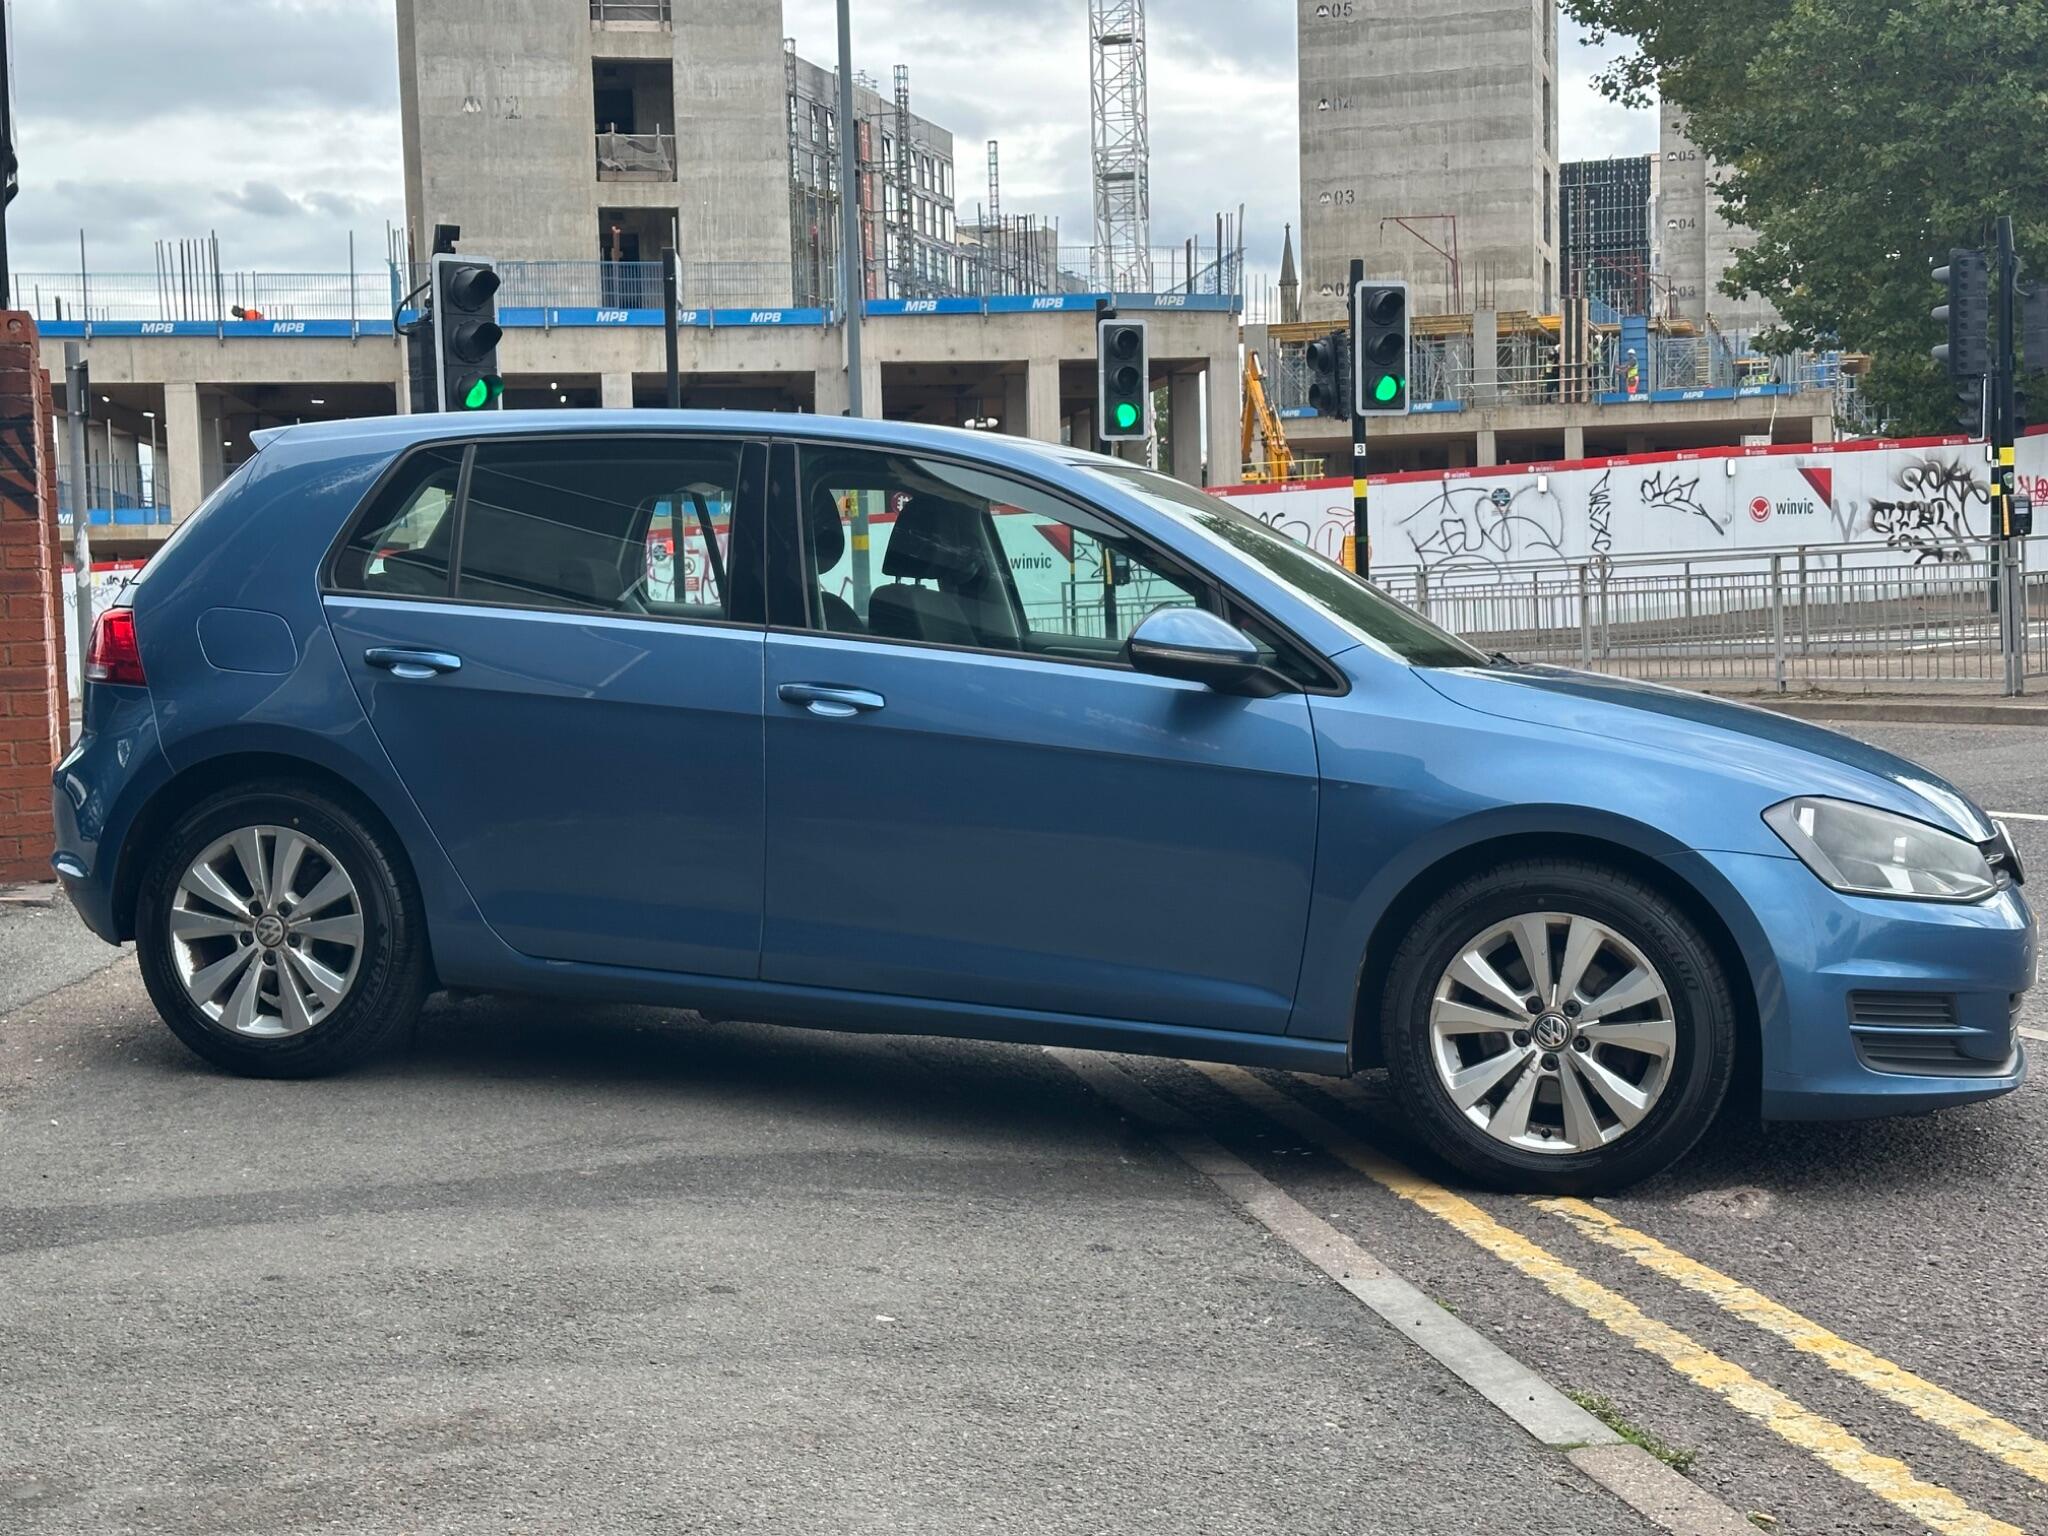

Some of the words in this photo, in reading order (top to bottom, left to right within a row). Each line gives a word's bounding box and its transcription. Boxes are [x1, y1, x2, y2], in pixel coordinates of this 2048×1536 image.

[1332, 1, 1352, 18] 05
[1334, 189, 1355, 205] 03
[904, 301, 937, 312] MPB
[1032, 297, 1064, 309] MPB
[1154, 295, 1186, 307] MPB
[596, 311, 628, 323] MPB
[679, 310, 697, 323] MP
[750, 311, 782, 323] MPB
[141, 322, 174, 334] MPB
[272, 322, 305, 334] MPB
[1683, 390, 1704, 399] MPB
[1356, 444, 1364, 455] 3
[1776, 497, 1814, 515] winvic
[1010, 552, 1052, 569] winvic
